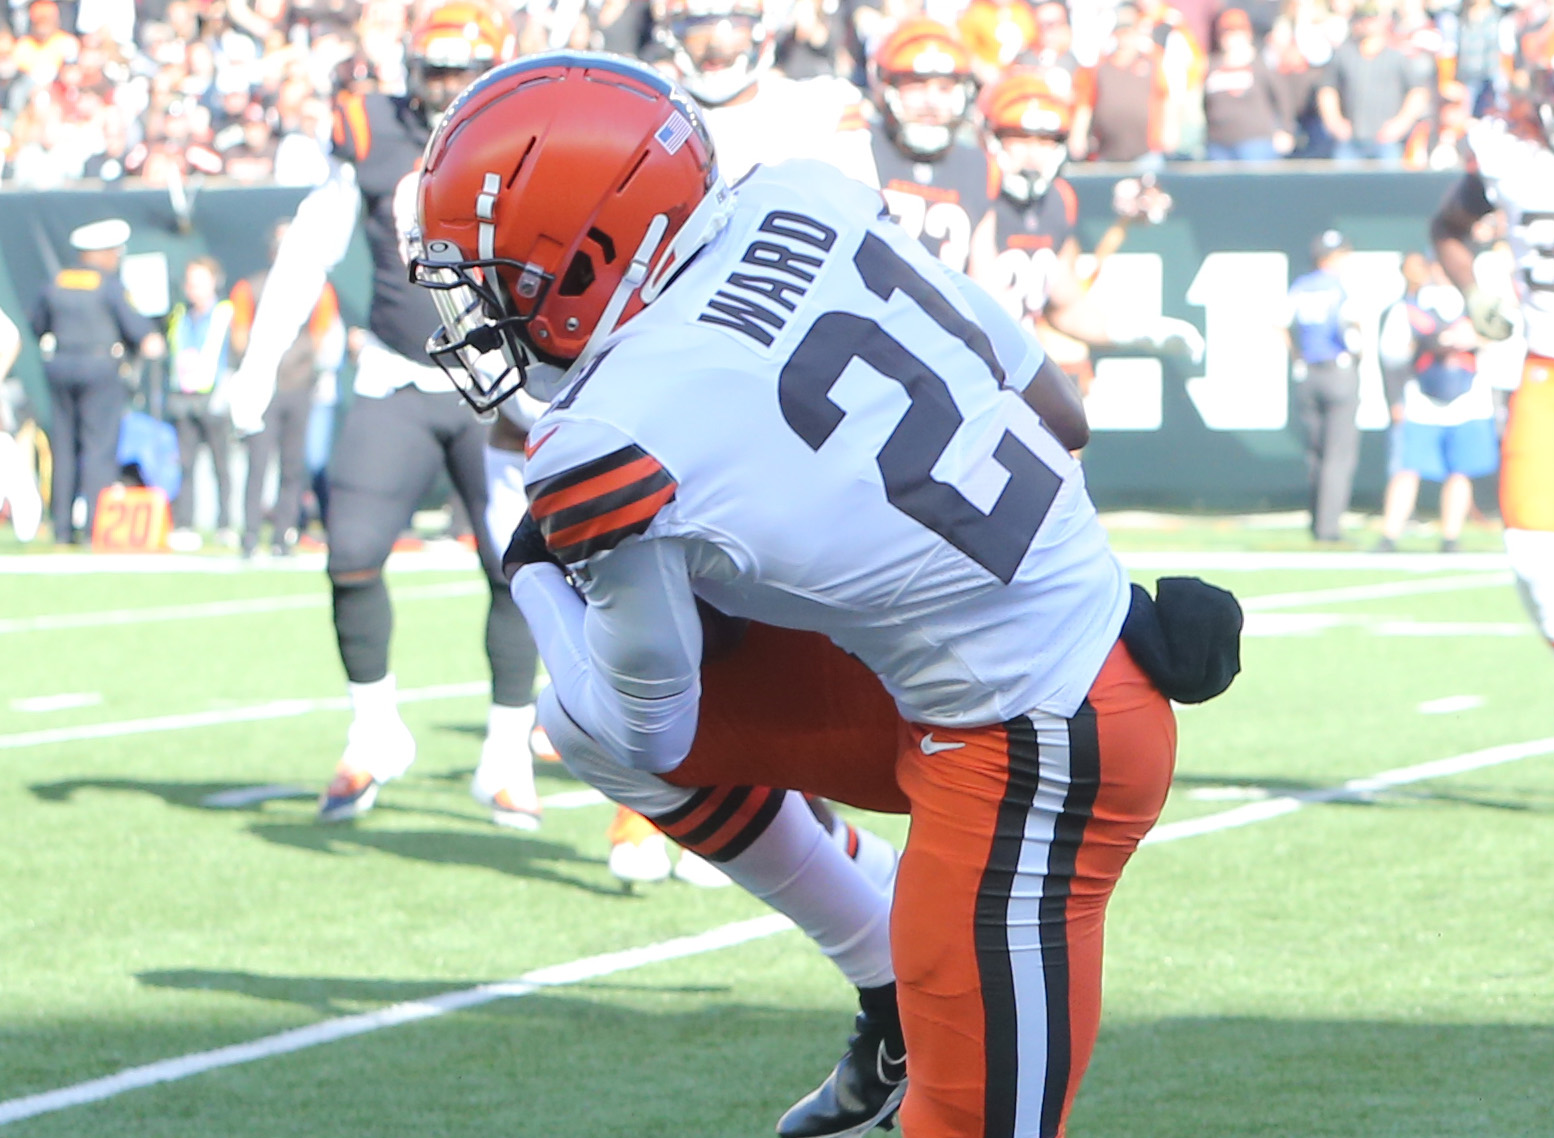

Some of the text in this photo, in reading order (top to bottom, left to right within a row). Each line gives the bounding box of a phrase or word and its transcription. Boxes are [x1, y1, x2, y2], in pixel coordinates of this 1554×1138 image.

[697, 209, 838, 348] WARD
[778, 230, 1064, 586] 21
[103, 502, 152, 548] 20
